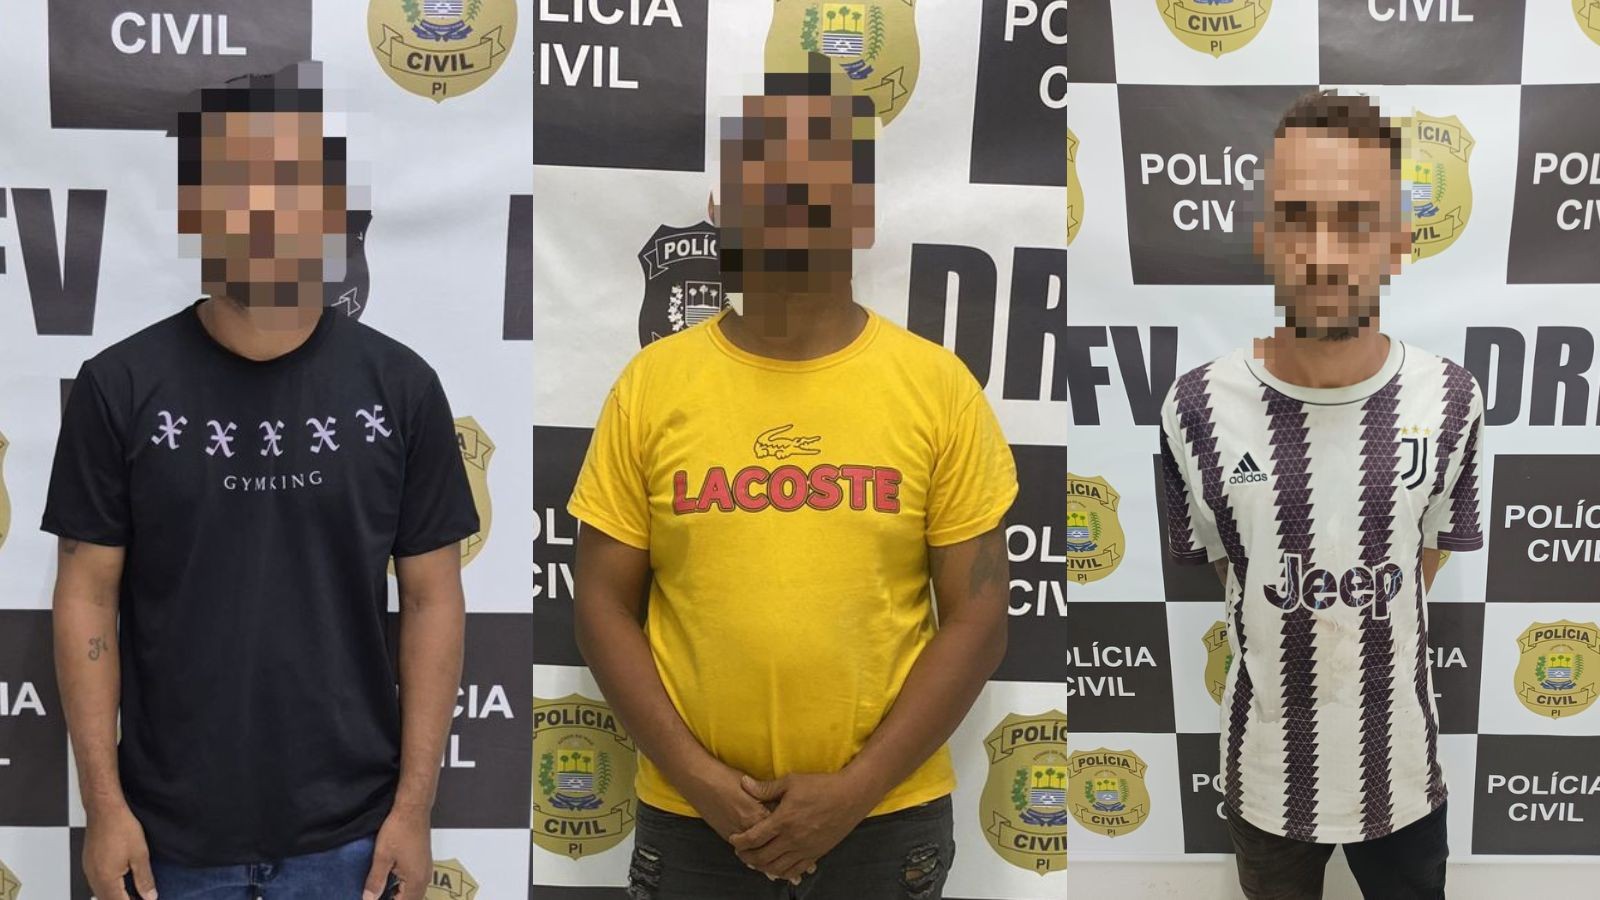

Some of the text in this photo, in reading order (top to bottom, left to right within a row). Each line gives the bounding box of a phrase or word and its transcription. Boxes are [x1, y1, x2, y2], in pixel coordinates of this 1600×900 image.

[1367, 0, 1474, 22] CIVIL
[1187, 14, 1243, 32] CIVIL
[110, 12, 247, 56] CIVIL
[1210, 40, 1223, 52] PI
[407, 52, 474, 72] CIVIL
[432, 82, 447, 95] PI
[1463, 326, 1600, 426] DR
[223, 470, 323, 491] GYMKING
[1229, 471, 1268, 484] adidas
[673, 464, 903, 516] LACOSTE
[1067, 558, 1102, 569] IVIL
[1077, 573, 1087, 581] PI
[1263, 552, 1404, 620] Jeep
[1534, 626, 1590, 642] POLÍCIA
[1067, 642, 1157, 667] LÍCIA
[1536, 695, 1578, 706] CIVIL
[533, 706, 617, 732] POLÍCIA
[1551, 709, 1560, 717] PI
[1078, 754, 1131, 768] POLÍCIA
[1091, 814, 1130, 826] CIVIL
[1508, 802, 1584, 822] CIVIL
[544, 819, 606, 836] CIVIL
[1107, 828, 1115, 836] PI
[568, 843, 582, 854] PI
[1036, 858, 1049, 870] PI
